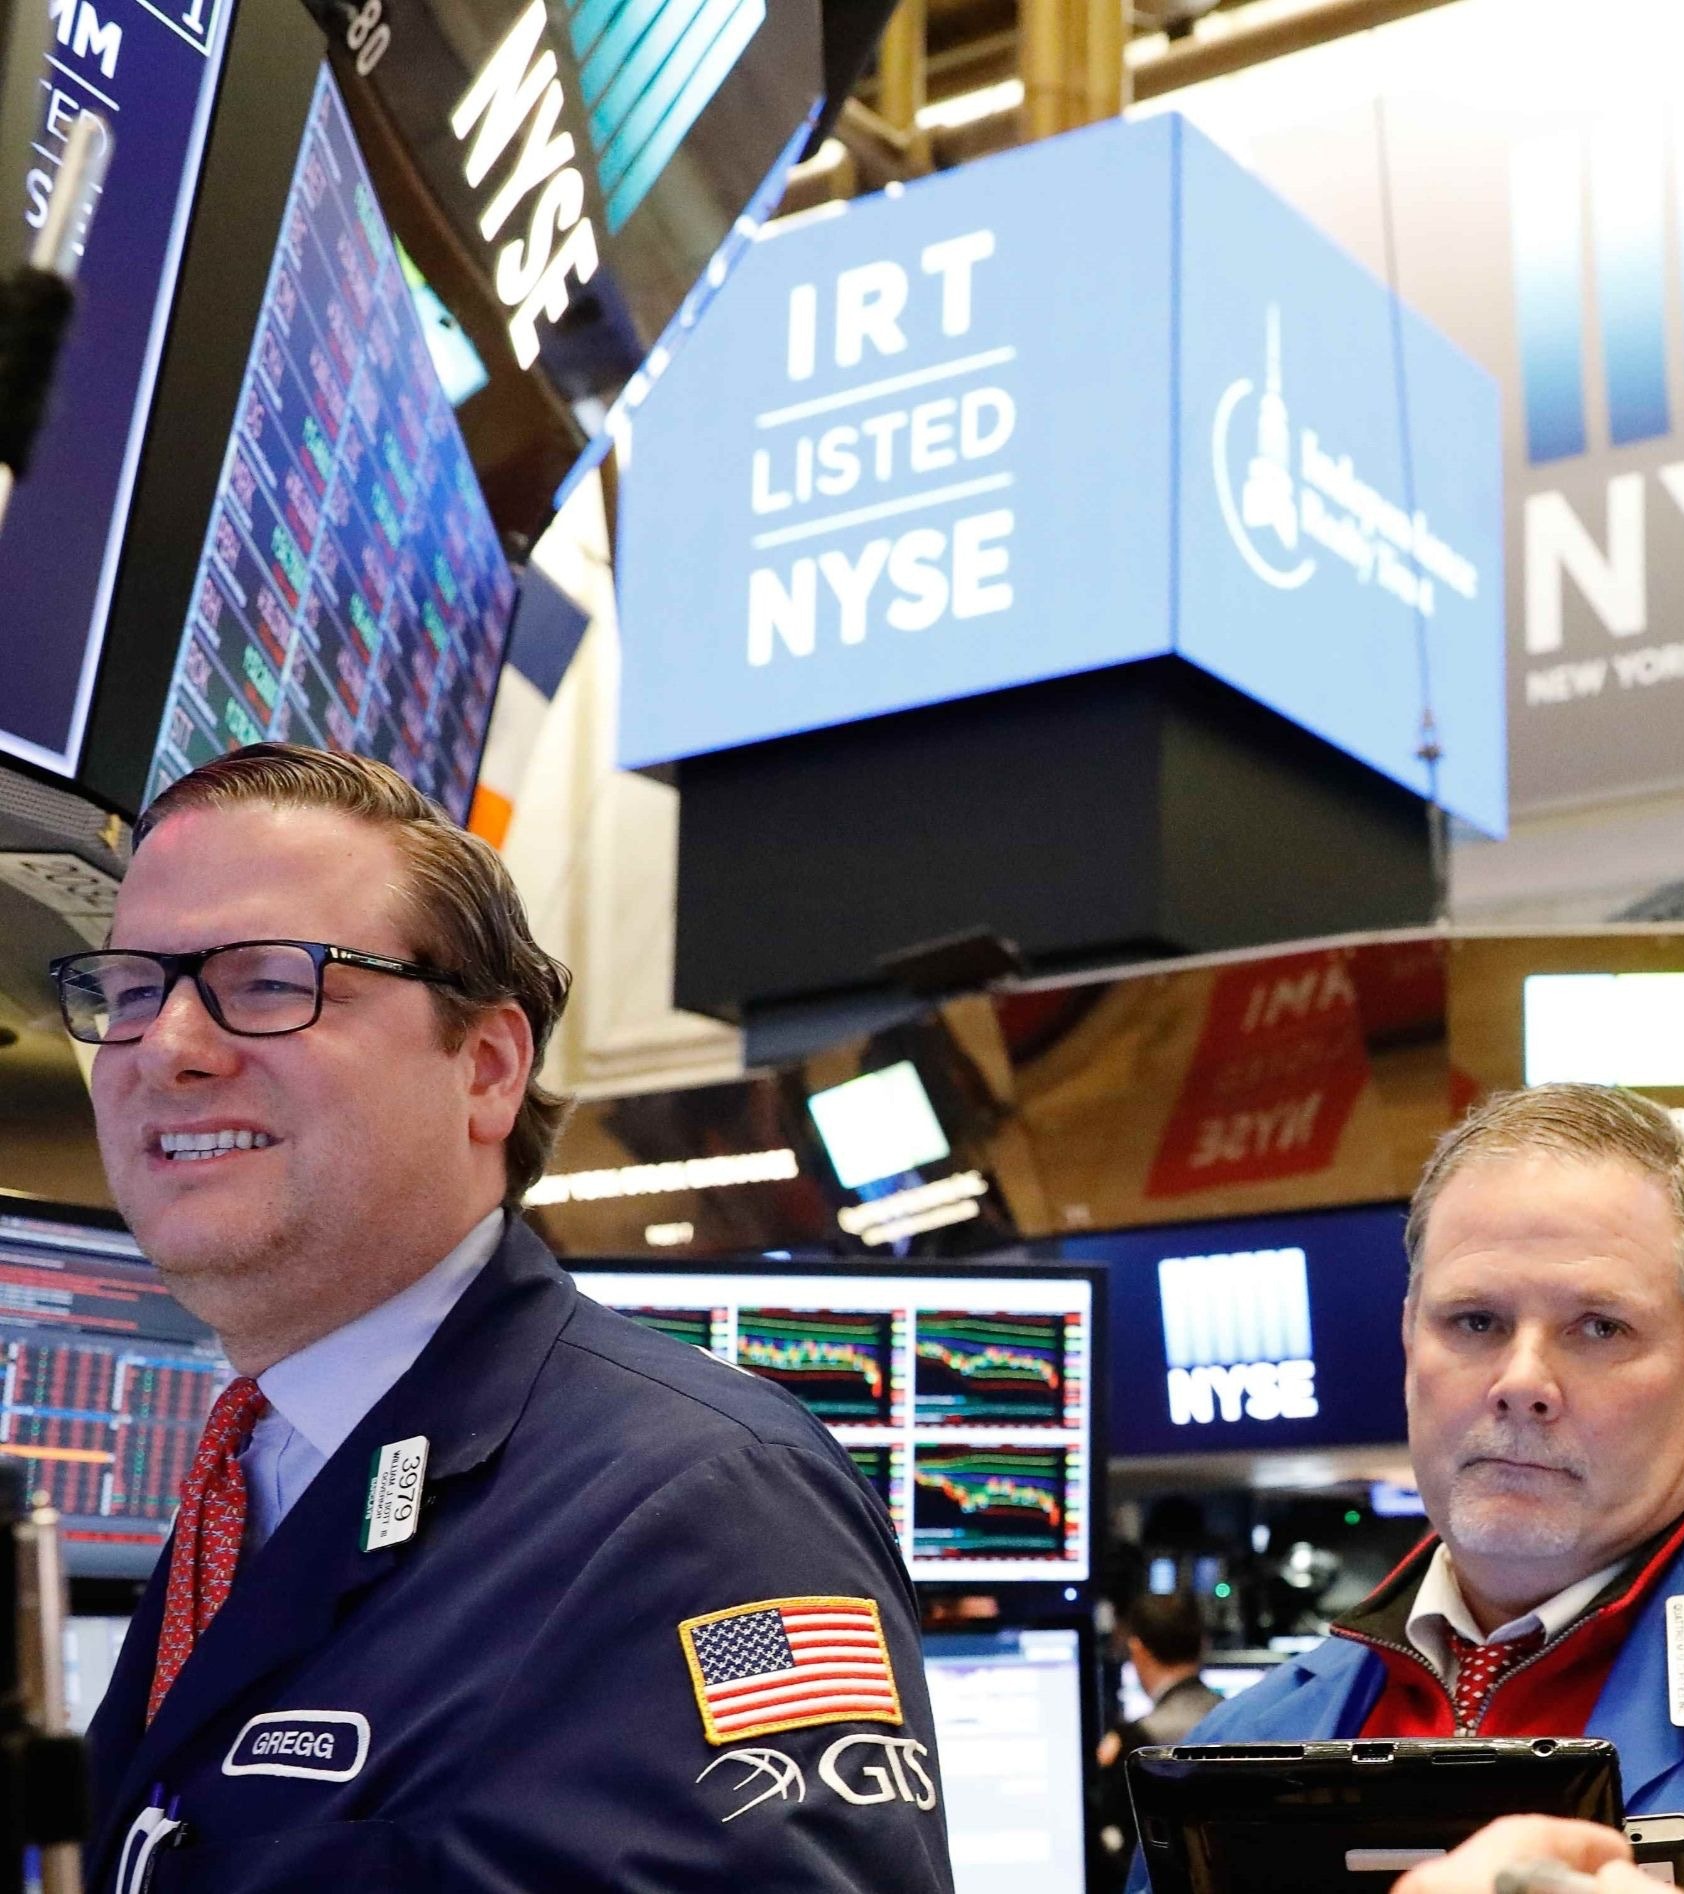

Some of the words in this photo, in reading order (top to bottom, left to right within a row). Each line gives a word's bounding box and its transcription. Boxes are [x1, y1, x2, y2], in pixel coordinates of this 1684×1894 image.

[450, 0, 599, 371] NYSE
[787, 228, 996, 382] IRT
[751, 386, 1016, 515] LISTED
[748, 507, 1015, 667] NYSE
[1525, 656, 1608, 707] NEW
[1166, 1358, 1319, 1426] NYSE
[393, 1456, 421, 1522] 3979
[252, 1731, 336, 1759] GREGG
[818, 1733, 936, 1811] GTS
